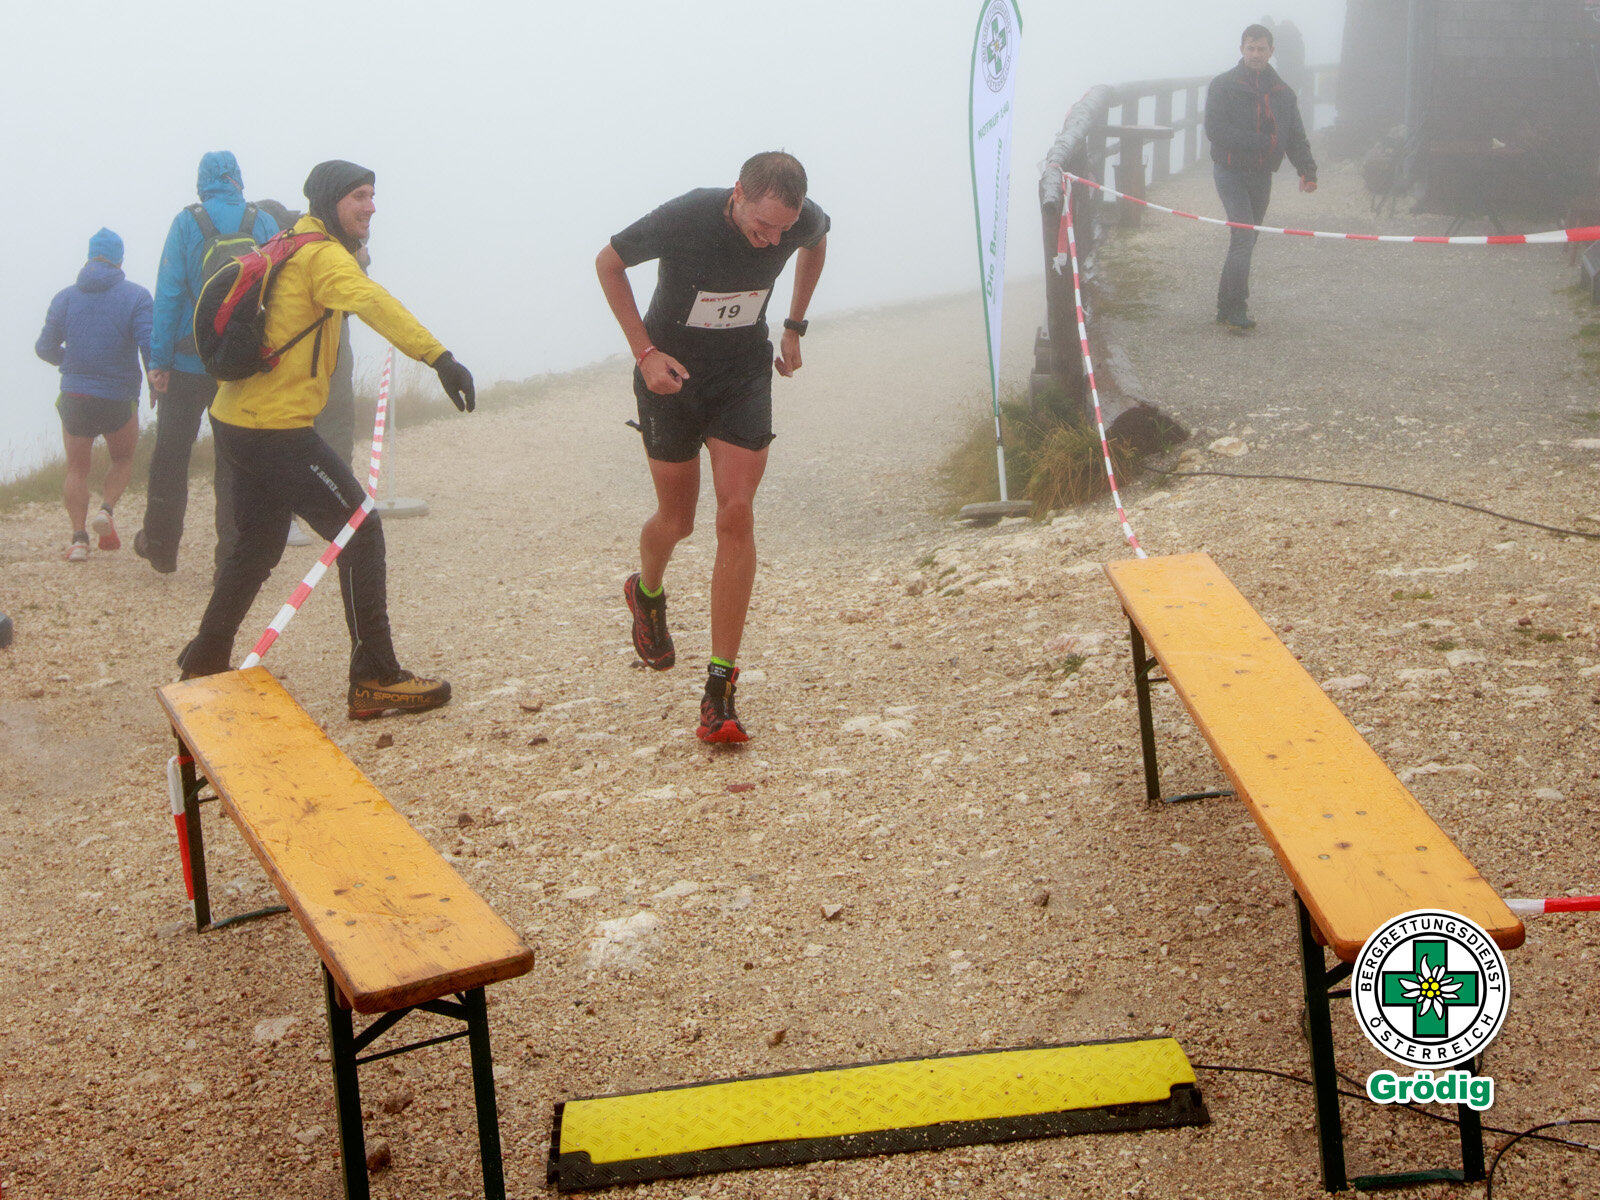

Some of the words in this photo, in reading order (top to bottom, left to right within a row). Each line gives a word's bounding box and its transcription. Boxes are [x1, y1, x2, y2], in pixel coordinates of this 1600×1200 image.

[977, 112, 999, 141] NOTRUF
[986, 263, 995, 298] Die
[717, 304, 741, 319] 19
[355, 688, 370, 699] LA
